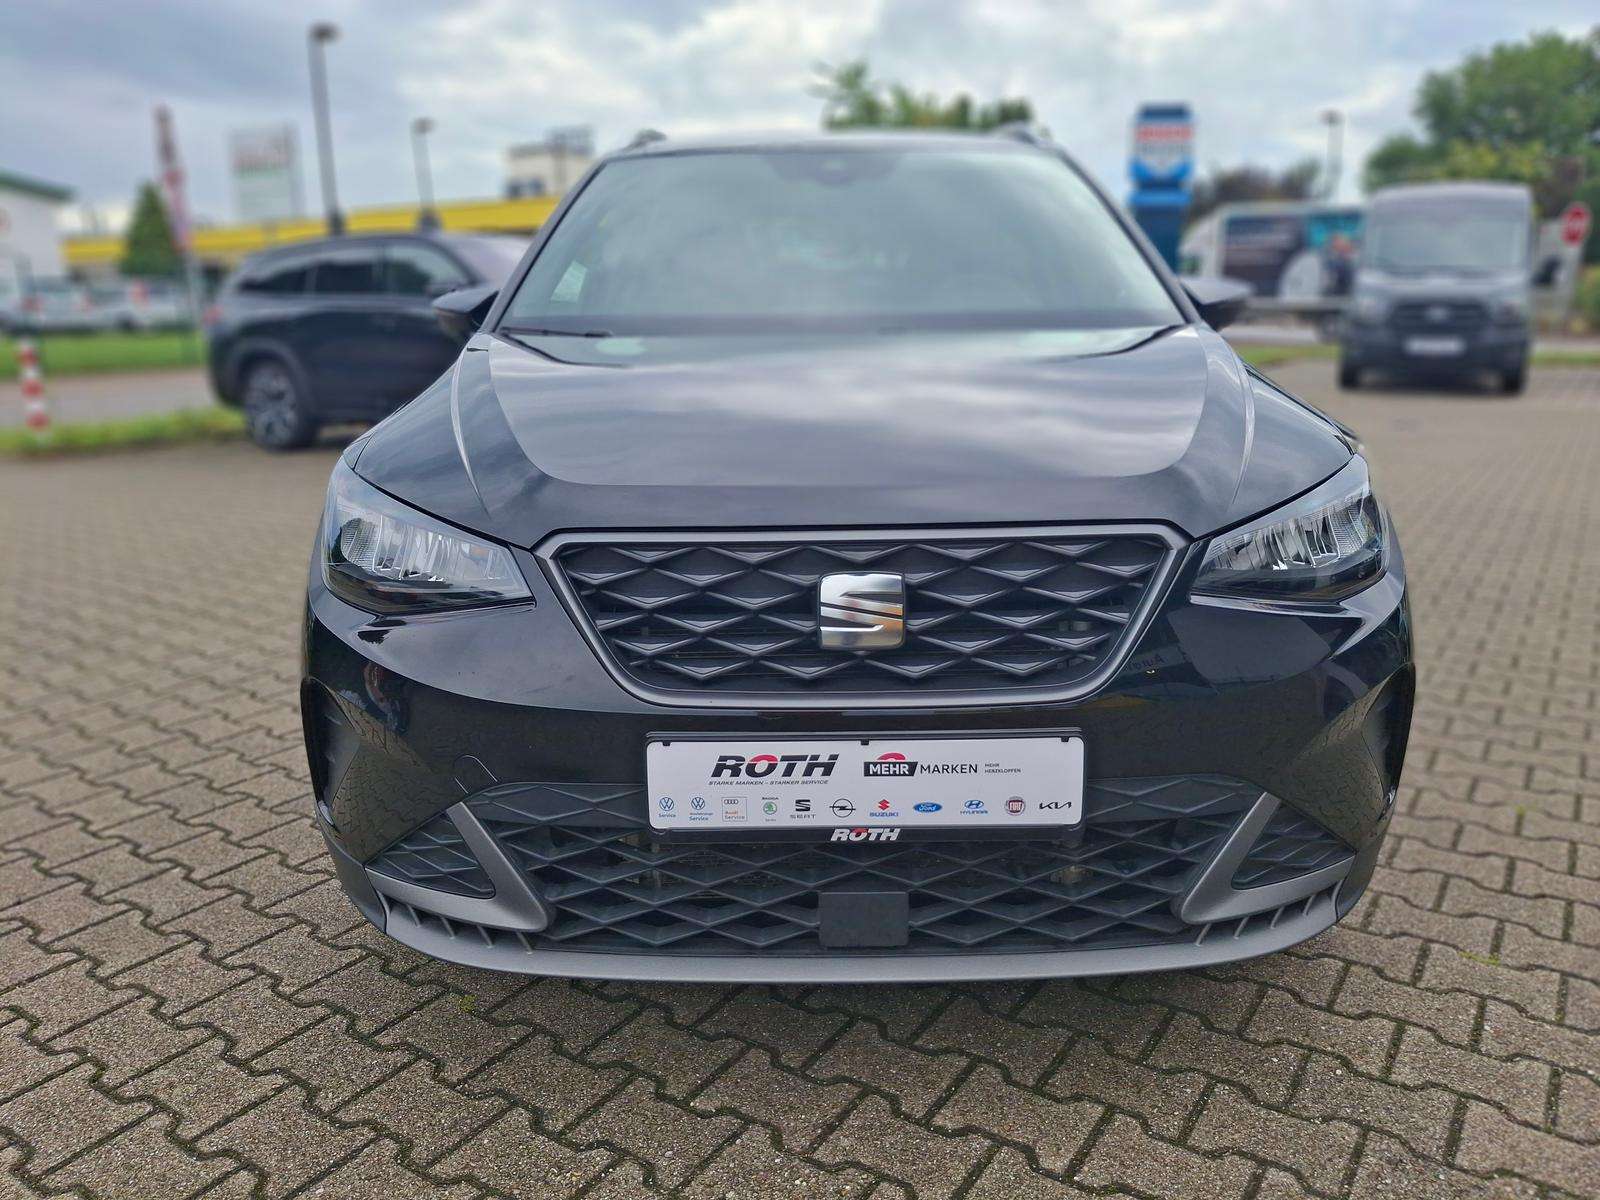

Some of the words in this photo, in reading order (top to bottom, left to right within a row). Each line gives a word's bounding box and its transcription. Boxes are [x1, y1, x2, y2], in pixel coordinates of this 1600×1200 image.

[711, 754, 840, 778] ROTH
[869, 764, 910, 775] MEHR
[920, 763, 978, 774] MARKEN
[829, 828, 901, 841] ROTH
